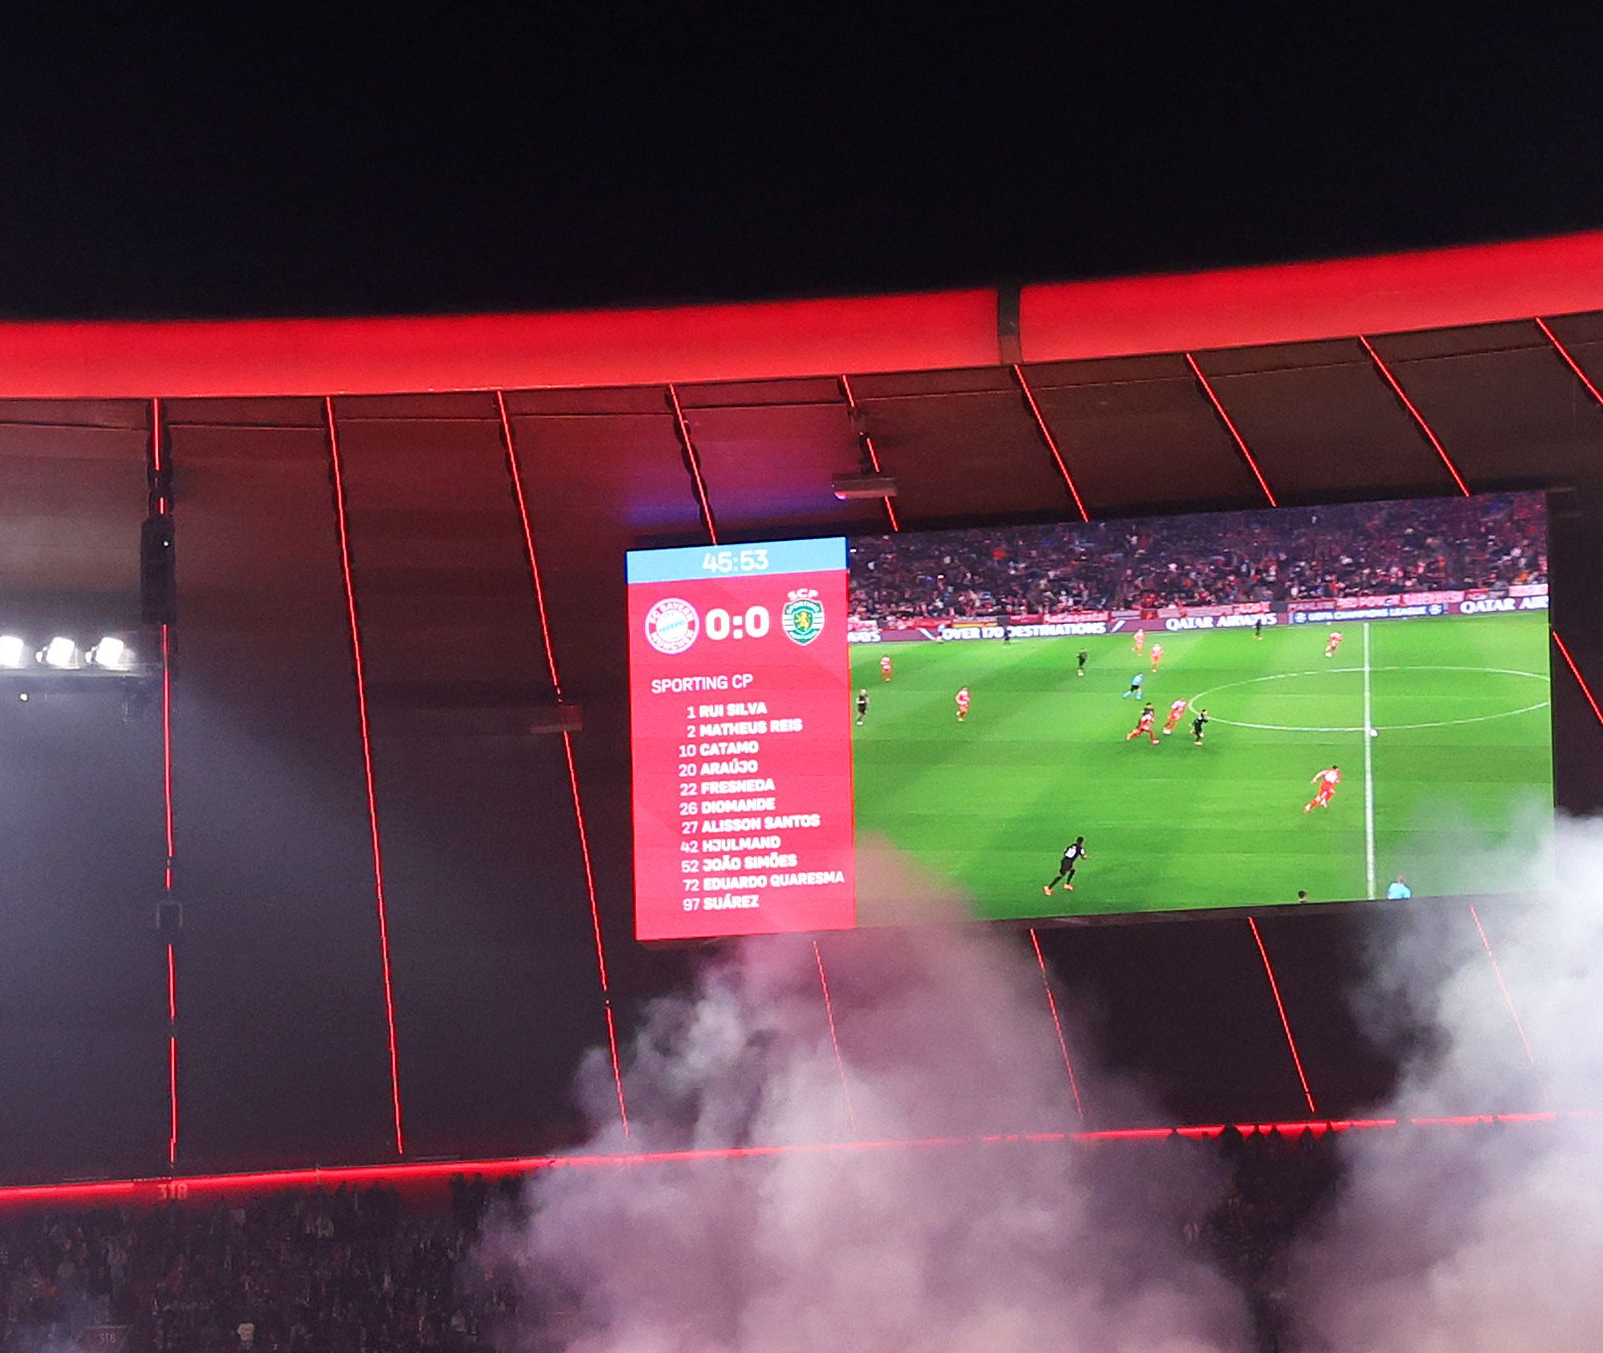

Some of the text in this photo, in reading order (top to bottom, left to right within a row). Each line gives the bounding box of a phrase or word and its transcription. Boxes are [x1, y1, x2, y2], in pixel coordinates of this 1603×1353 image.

[702, 549, 769, 573] 45:53
[1460, 596, 1516, 614] QATAR
[705, 606, 770, 640] 0:0
[1165, 615, 1213, 632] QATAR
[651, 674, 753, 694] SPORTING CP
[687, 701, 767, 719] 1 RUI SILVA
[687, 718, 803, 738] 2 MATHEUS REIS
[678, 741, 759, 758] 10 CATAMO
[678, 758, 758, 776] 20 ARAÚJO
[679, 778, 775, 796] 22 FRESNEDA
[679, 797, 776, 815] 26 DIOMANDE
[682, 814, 820, 834] 27 ALISSON SANTOS
[680, 836, 780, 853] 42 HJULMAND
[681, 852, 797, 873] 52 JOÃO SIMÕES
[682, 871, 844, 891] 72 EDUARDO QUARESMA
[683, 892, 759, 911] 97 SUÁREZ
